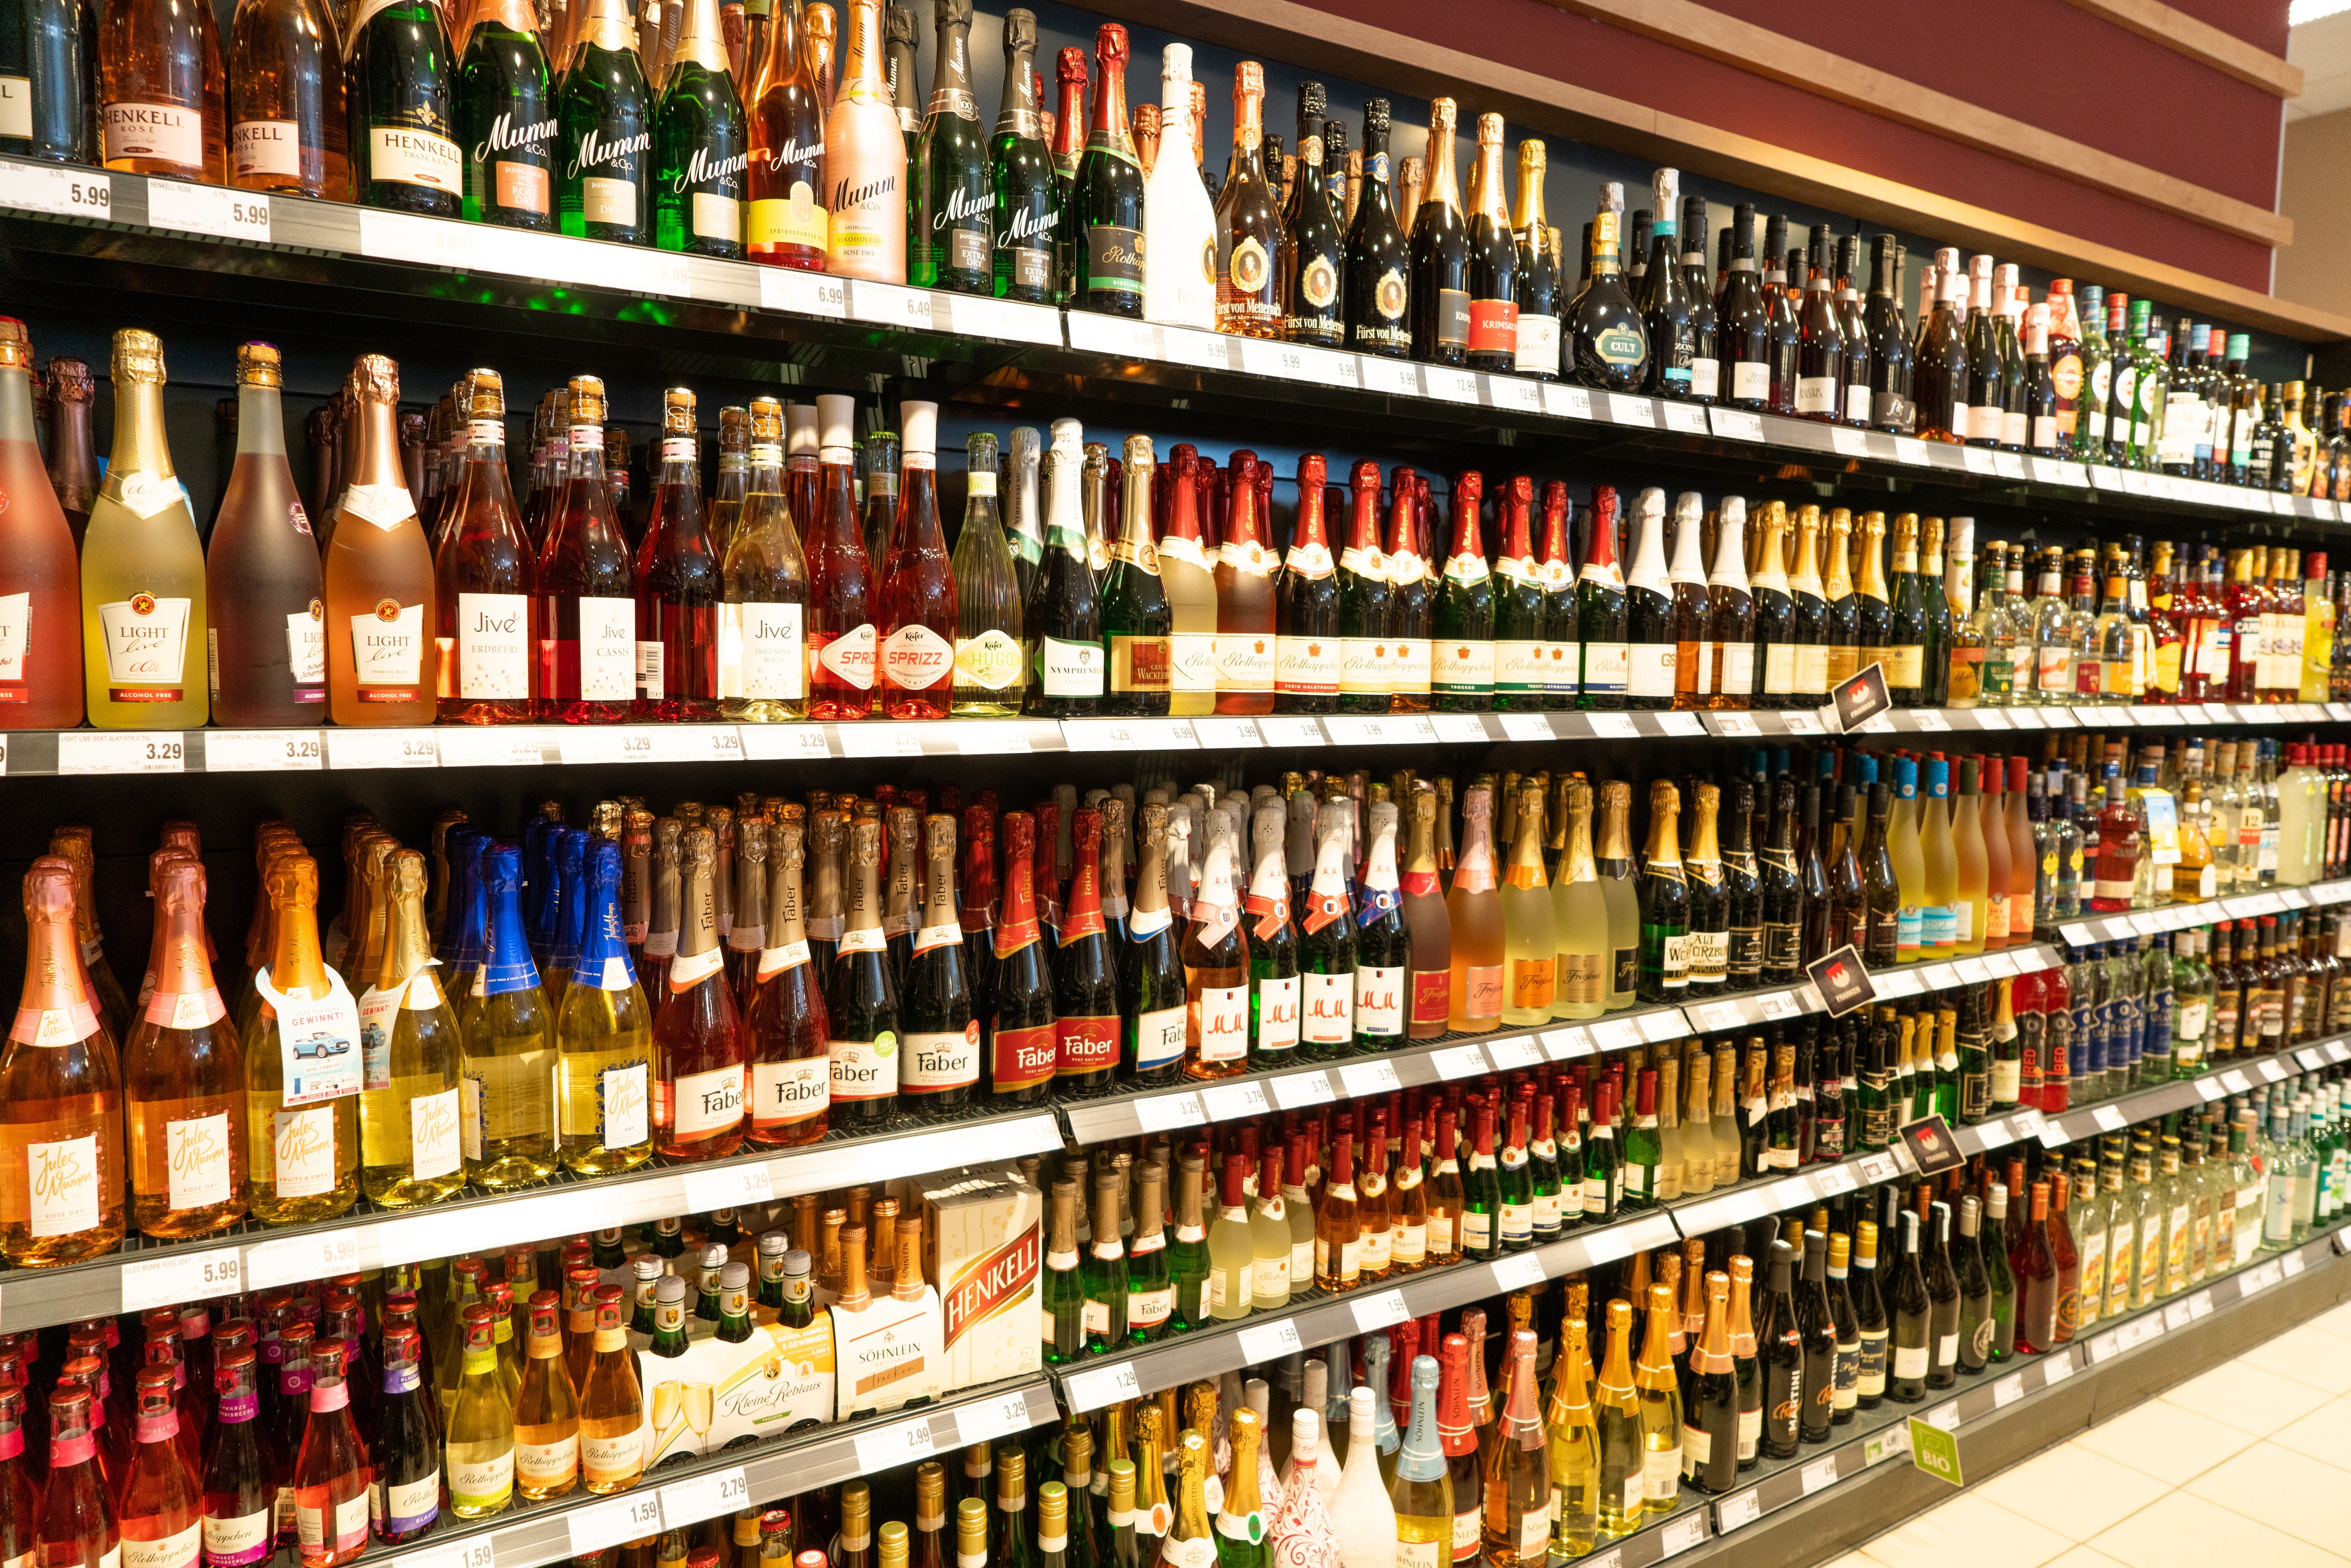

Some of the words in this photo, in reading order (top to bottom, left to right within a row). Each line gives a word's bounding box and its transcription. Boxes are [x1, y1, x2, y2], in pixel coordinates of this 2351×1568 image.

[950, 36, 966, 83] Mumm
[105, 110, 185, 129] HENKELL
[121, 124, 155, 134] ROSÉ
[475, 112, 559, 163] Mumm
[385, 133, 459, 165] HENKELL
[525, 143, 547, 158] &Co.
[568, 129, 651, 180] Mumm
[771, 138, 825, 171] Mumm
[403, 151, 449, 167] TROCKEN
[49, 170, 66, 179] 0,75L
[505, 167, 542, 179] JAHRGANGS
[675, 147, 747, 194] Mumm
[71, 184, 110, 207] 5.99
[150, 181, 174, 191] HENKELL
[175, 184, 192, 194] ROSE
[213, 191, 229, 199] 0,75L
[512, 186, 538, 198] ROSÉ
[515, 195, 536, 207] DRY
[828, 175, 897, 222] Mumm
[233, 203, 268, 226] 5.99
[600, 205, 621, 215] DRY
[934, 187, 995, 229] Mumm
[998, 206, 1058, 247] Mumm
[770, 228, 816, 242] SPÄTBURGUNDER
[836, 236, 884, 245] ALKOHOLFREI
[960, 234, 987, 244] JAHRGANGS
[843, 248, 859, 257] ROSÉ
[962, 250, 986, 261] EXTRA
[966, 257, 982, 268] DRY
[661, 264, 688, 284] 6.49
[1025, 268, 1048, 278] EXTRA
[1029, 275, 1045, 284] DRY
[819, 286, 844, 305] 6.99
[907, 299, 931, 317] 6.49
[1231, 304, 1244, 315] von
[1357, 325, 1373, 339] Fürst
[1375, 330, 1388, 339] von
[1207, 343, 1226, 359] 9.99
[1518, 341, 1542, 352] GRAND
[1610, 341, 1636, 353] CULT
[1283, 354, 1300, 369] 9.99
[1338, 363, 1355, 377] 9.99
[1400, 372, 1416, 386] 9.99
[1456, 378, 1475, 393] 12.99
[1519, 387, 1538, 402] 12.99
[1571, 395, 1589, 409] 12.99
[474, 612, 516, 634] Jive
[755, 620, 793, 639] Jive
[120, 626, 169, 638] LIGHT
[602, 624, 626, 639] Jive
[905, 631, 927, 642] Käfer
[118, 639, 164, 655] live
[366, 636, 411, 647] LIGHT
[985, 640, 1005, 651] Käfer
[365, 647, 407, 662] live
[471, 645, 520, 654] ERDBEERE
[597, 647, 630, 657] CASSIS
[889, 652, 942, 666] SPRIZZ
[971, 652, 1013, 666] HUGO
[1279, 654, 1339, 673] Rotkäppchen
[1434, 656, 1492, 674] Rotkäppchen
[891, 668, 941, 679] BITTERORANGENGESCHMACK
[1050, 666, 1104, 675] NYMPHENBUR
[1850, 699, 1876, 719] FRANKEN
[1110, 728, 1129, 741] 4.29
[1173, 726, 1193, 740] 6.99
[1237, 726, 1256, 739] 3.99
[1301, 725, 1319, 737] 3.99
[1364, 724, 1381, 736] 3.99
[1415, 723, 1432, 734] 3.99
[509, 739, 539, 753] 3.29
[623, 736, 651, 751] 3.29
[713, 735, 739, 749] 3.29
[801, 733, 826, 748] 3.29
[893, 732, 918, 746] 3.79
[146, 743, 182, 760] 3.29
[286, 741, 319, 758] 3.29
[403, 740, 434, 756] 3.29
[1836, 986, 1862, 1002] FRANKEN
[312, 1006, 341, 1014] FLASCHE
[292, 1013, 344, 1026] GEWINNT!
[1064, 1034, 1112, 1056] Faber
[1573, 1035, 1589, 1047] 5.99
[1522, 1043, 1538, 1056] 5.99
[917, 1052, 969, 1073] Faber
[1017, 1046, 1057, 1070] Faber
[1467, 1053, 1484, 1066] 5.99
[2054, 1047, 2065, 1073] RED
[829, 1062, 879, 1082] Faber
[1377, 1068, 1396, 1081] 3.79
[609, 1072, 638, 1108] Jules
[775, 1079, 826, 1104] Faber
[1311, 1079, 1329, 1093] 3.79
[702, 1087, 744, 1115] Faber
[1244, 1090, 1264, 1104] 3.79
[418, 1097, 449, 1133] Jules
[615, 1095, 645, 1123] Mumm
[1179, 1101, 1200, 1115] 3.29
[281, 1112, 319, 1161] Jules
[425, 1120, 457, 1152] Mumm
[173, 1122, 214, 1171] Jules
[287, 1138, 330, 1170] Mumm
[181, 1148, 225, 1181] Mumm
[421, 1156, 442, 1165] MEDIUM
[35, 1145, 80, 1196] Jules
[44, 1171, 92, 1206] Mumm
[743, 1172, 770, 1191] 3.29
[45, 1210, 66, 1219] ROSÉ
[68, 1208, 84, 1217] DRY
[323, 1240, 355, 1262] 5.99
[123, 1265, 141, 1274] JULES
[142, 1263, 161, 1272] MUMM
[162, 1261, 176, 1269] ROSE
[203, 1260, 238, 1282] 5.99
[946, 1237, 1037, 1334] HENKELL
[1140, 1301, 1168, 1316] Faber
[1388, 1298, 1405, 1313] 1.59
[776, 1332, 801, 1343] SUCHEN,
[803, 1326, 828, 1338] SAMMELN
[789, 1333, 829, 1348] GEWINNEN!
[1278, 1327, 1297, 1344] 1.59
[859, 1341, 921, 1364] SÖHNLEIN
[1019, 1346, 1036, 1366] 2
[876, 1357, 906, 1365] BRILLANT
[1019, 1363, 1036, 1371] BOTTLES
[1116, 1371, 1136, 1389] 1.29
[724, 1393, 776, 1418] Kleine
[767, 1380, 821, 1408] Reblaus
[1788, 1369, 1801, 1433] MARTINI
[761, 1413, 782, 1422] TROCKEN
[1003, 1401, 1026, 1420] 3.29
[1415, 1401, 1426, 1443] SÖHNLEIN
[907, 1426, 930, 1447] 2.99
[520, 1449, 574, 1467] Rotkäppchen
[586, 1442, 639, 1460] Rotkäppchen
[528, 1462, 568, 1473] FRUCHTSECCO
[594, 1456, 633, 1467] FRUCHTSECCO
[1922, 1450, 1951, 1473] BIO
[532, 1475, 563, 1484] PFIRSICH
[720, 1476, 746, 1499] 2.79
[631, 1500, 657, 1524] 1.59
[128, 1539, 195, 1564] Rotkäppchen
[462, 1546, 492, 1568] 1.59
